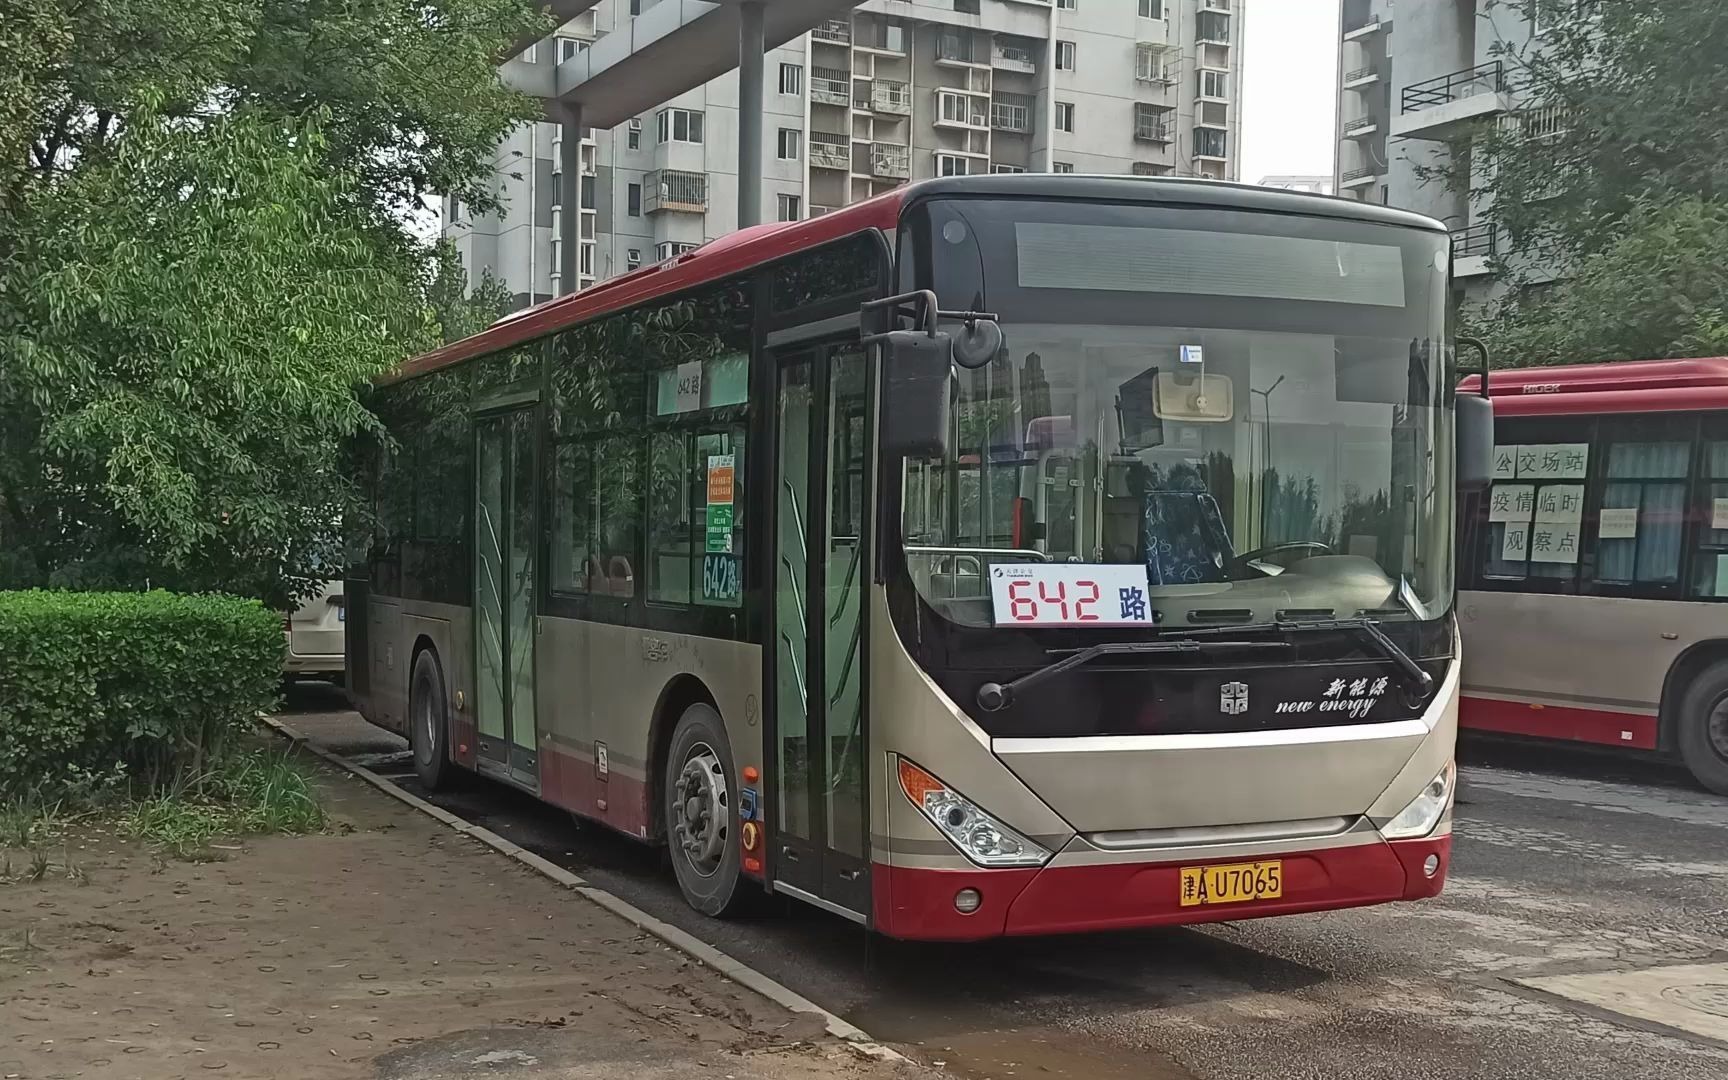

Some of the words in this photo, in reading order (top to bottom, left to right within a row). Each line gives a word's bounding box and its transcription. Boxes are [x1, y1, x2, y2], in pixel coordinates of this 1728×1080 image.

[1523, 384, 1561, 393] HIGER
[1496, 451, 1585, 472] 公交场站
[1492, 492, 1580, 513] 疫情临时
[1505, 530, 1576, 552] 观察点
[1322, 676, 1389, 699] 新能源
[1275, 700, 1315, 713] new
[1319, 698, 1378, 718] energy
